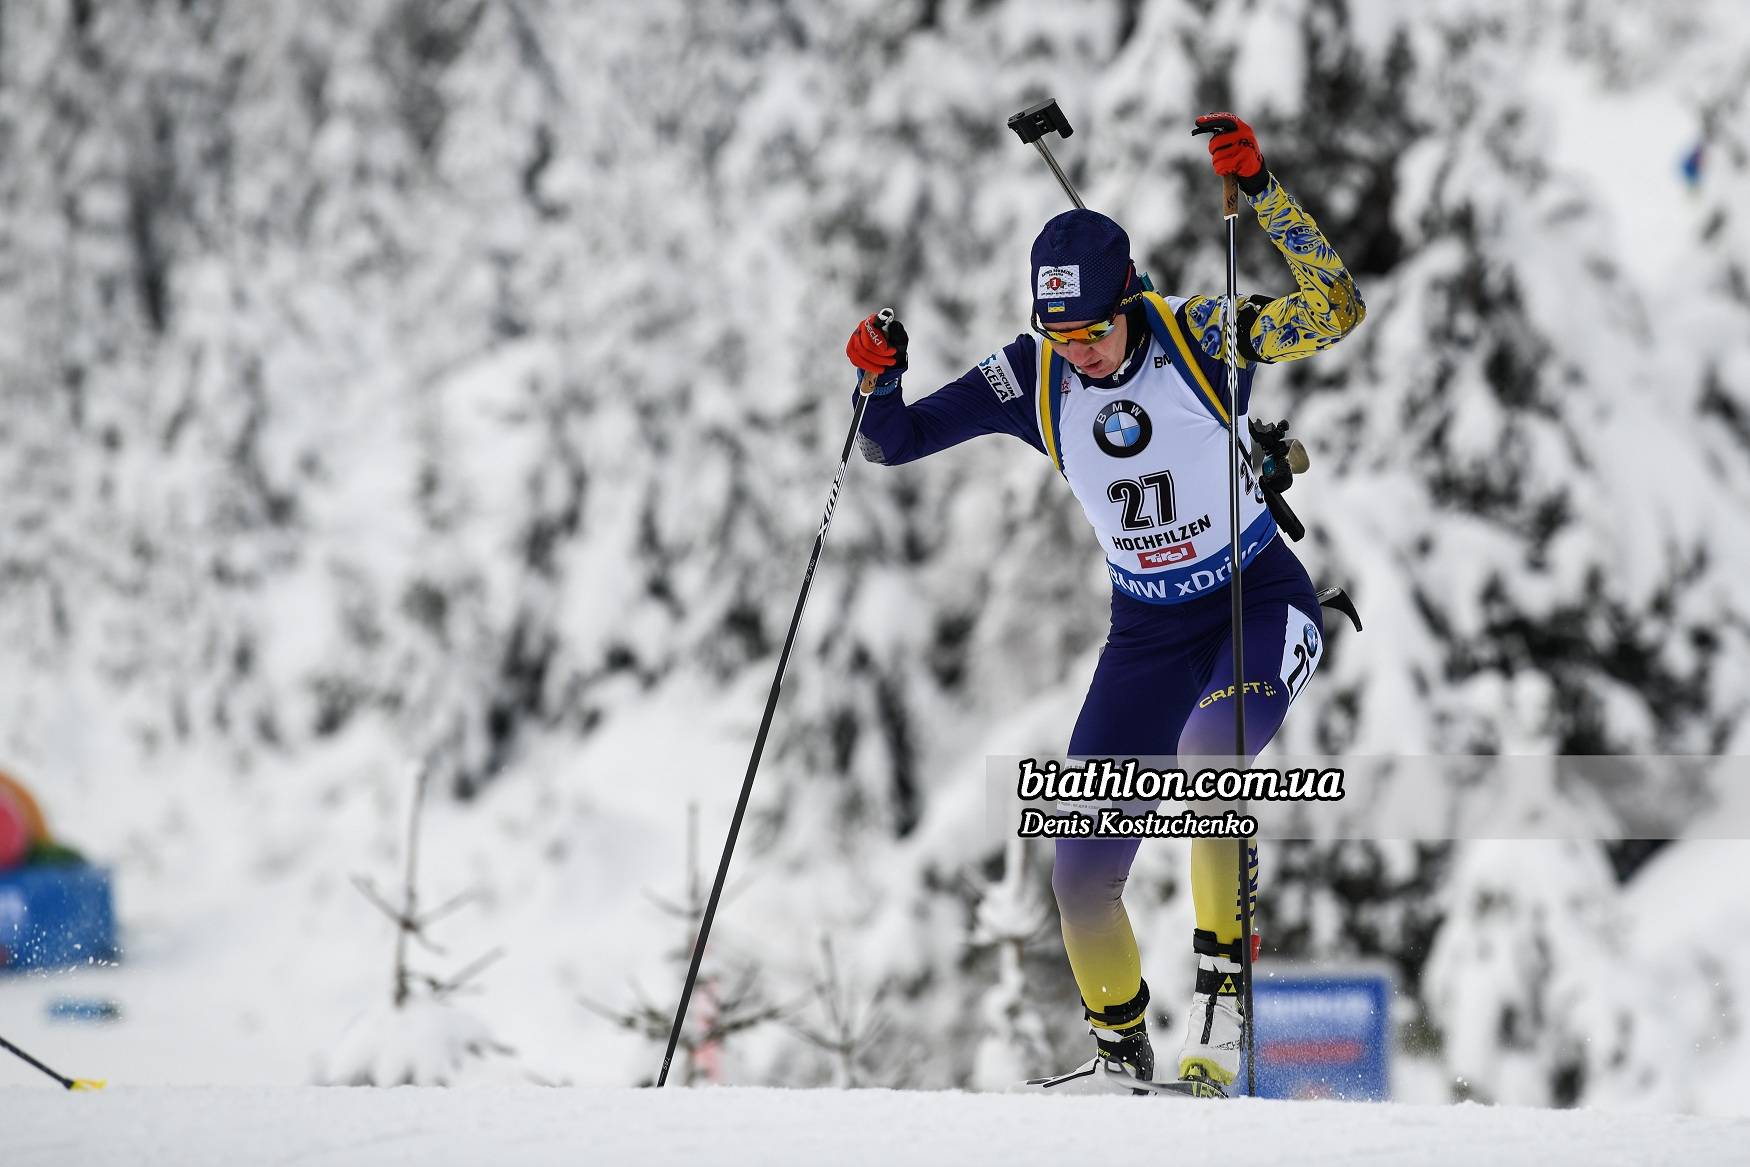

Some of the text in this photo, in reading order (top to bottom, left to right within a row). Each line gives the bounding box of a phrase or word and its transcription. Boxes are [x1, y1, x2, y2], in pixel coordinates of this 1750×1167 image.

[1154, 354, 1173, 369] BM
[995, 365, 1016, 397] TERCIUM
[1096, 402, 1143, 425] BMW
[1106, 469, 1177, 532] 27
[1112, 514, 1212, 551] HOCHFILZEN
[1106, 541, 1258, 599] BMW xDri
